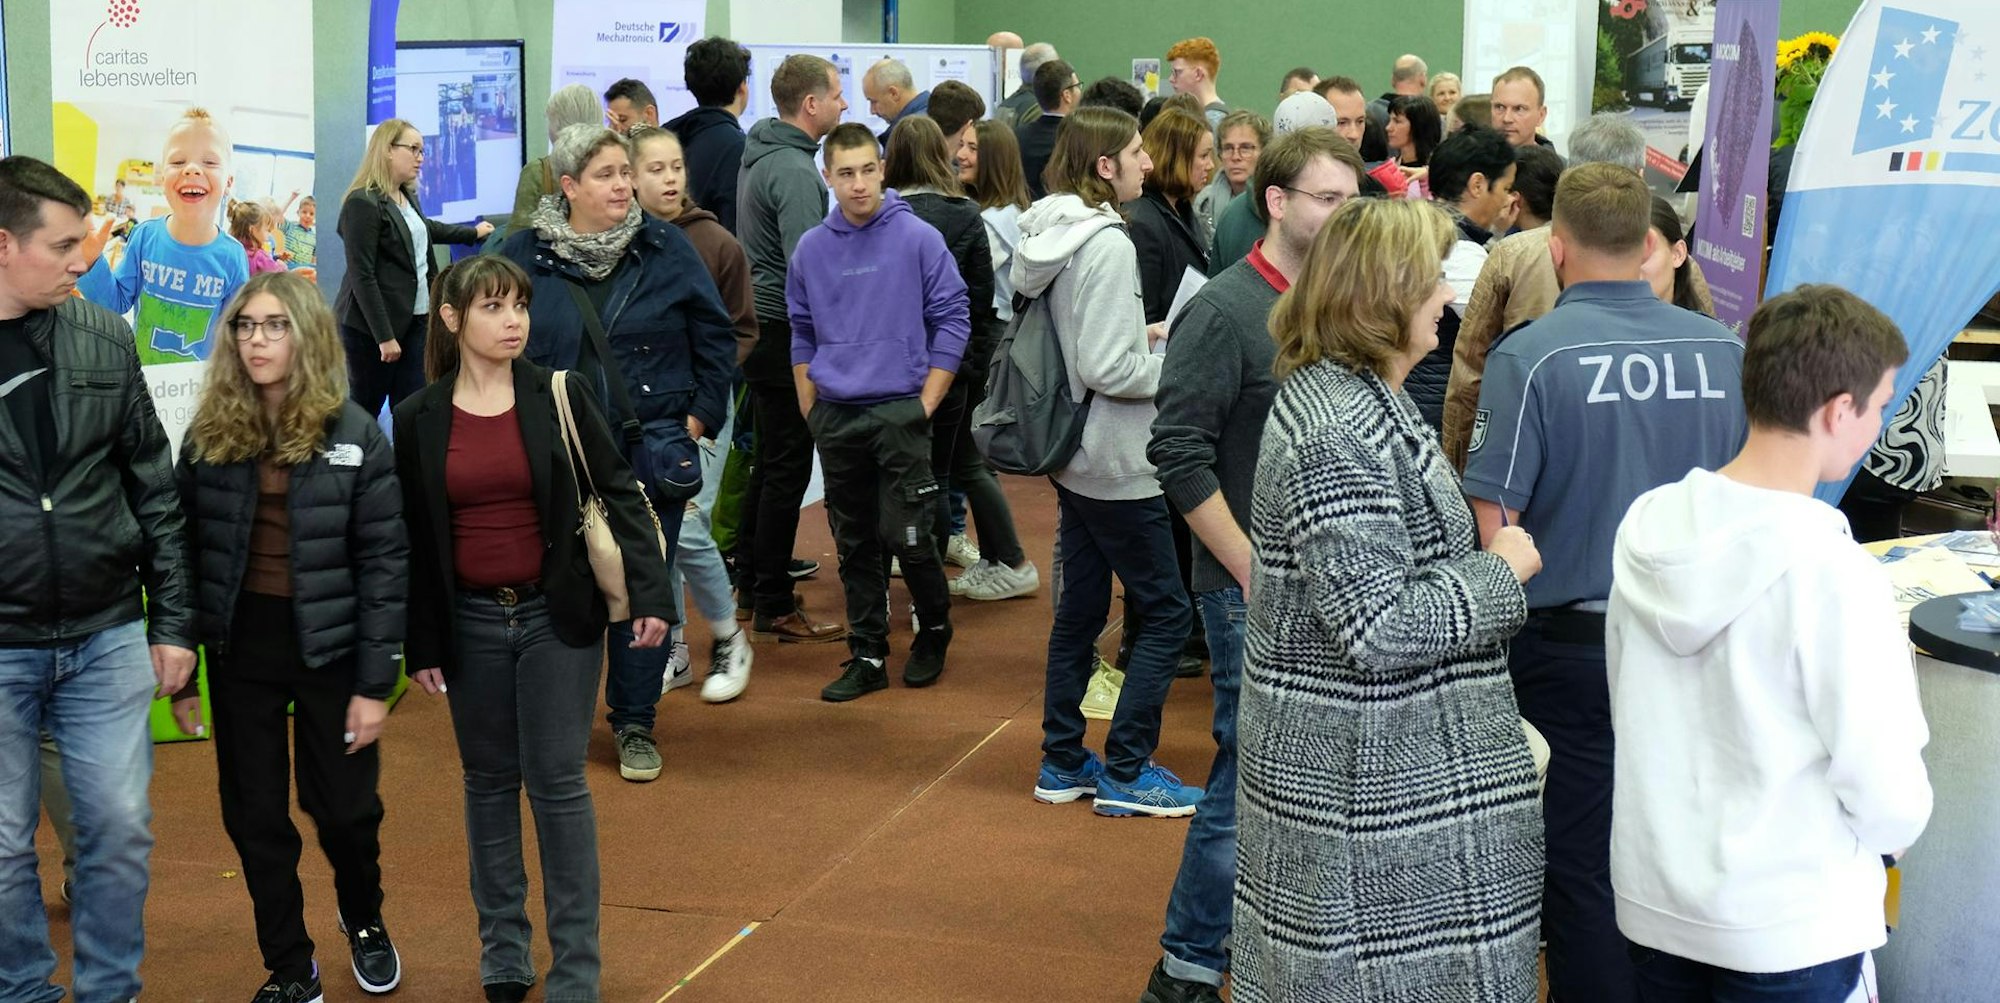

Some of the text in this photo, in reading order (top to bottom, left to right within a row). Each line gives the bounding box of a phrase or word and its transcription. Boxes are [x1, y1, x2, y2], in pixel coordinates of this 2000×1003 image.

[615, 21, 655, 32] Deutsche
[596, 32, 655, 43] Mechatronics
[95, 49, 148, 65] caritas
[80, 68, 197, 87] lebenswelten
[141, 260, 225, 298] GIVE ME
[1578, 352, 1726, 404] ZOLL
[149, 378, 201, 399] derh
